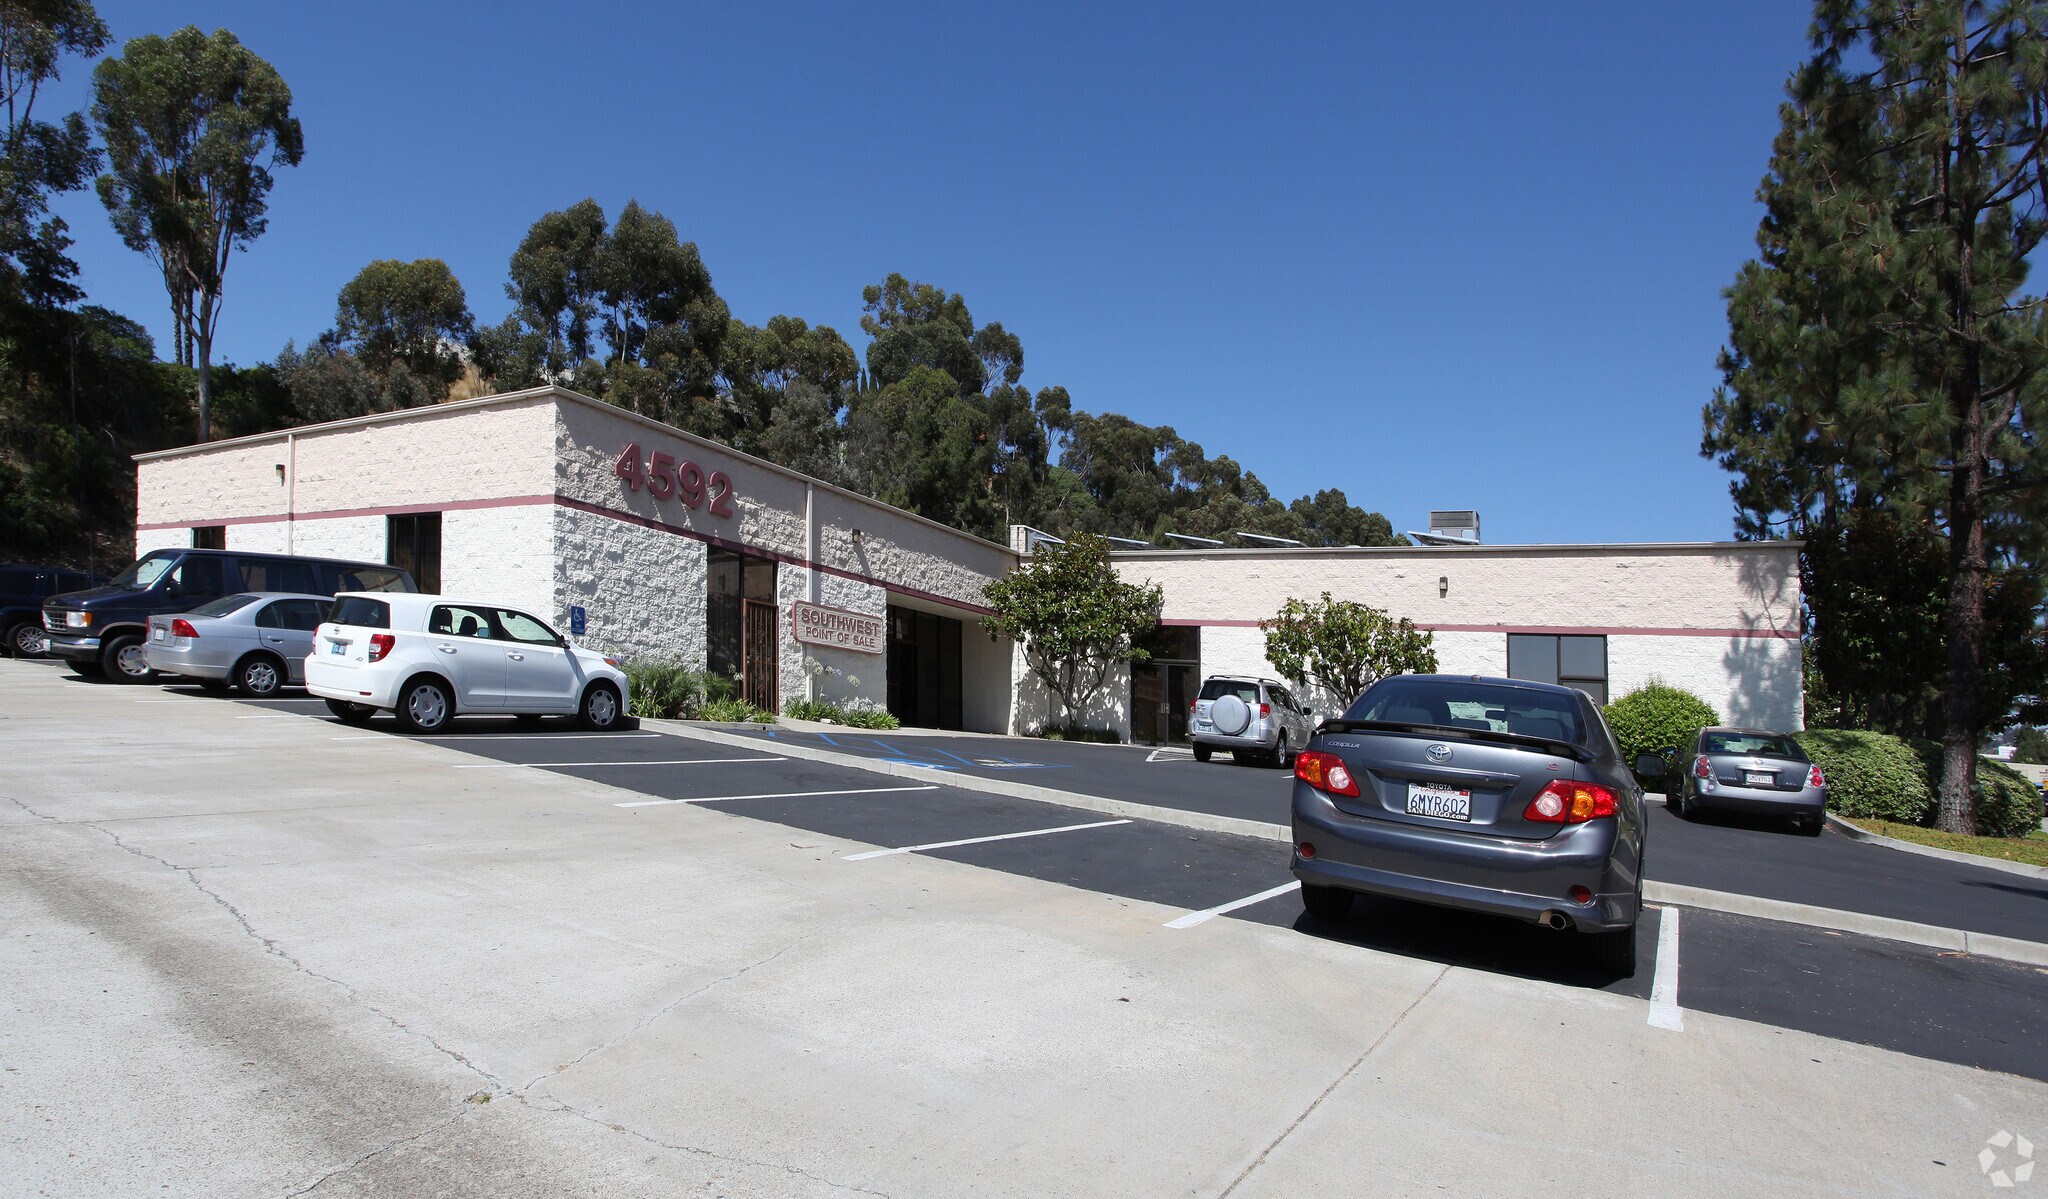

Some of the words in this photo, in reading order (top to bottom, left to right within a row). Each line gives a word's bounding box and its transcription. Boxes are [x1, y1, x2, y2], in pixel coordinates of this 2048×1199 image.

[614, 443, 733, 518] 4592
[801, 607, 879, 636] SOUTHWEST
[805, 626, 834, 641] POINT
[837, 631, 849, 643] OF
[853, 634, 875, 648] SALE
[1426, 782, 1452, 790] TOYOTA
[1407, 806, 1423, 815] SAN
[1410, 793, 1467, 813] 6MYR602
